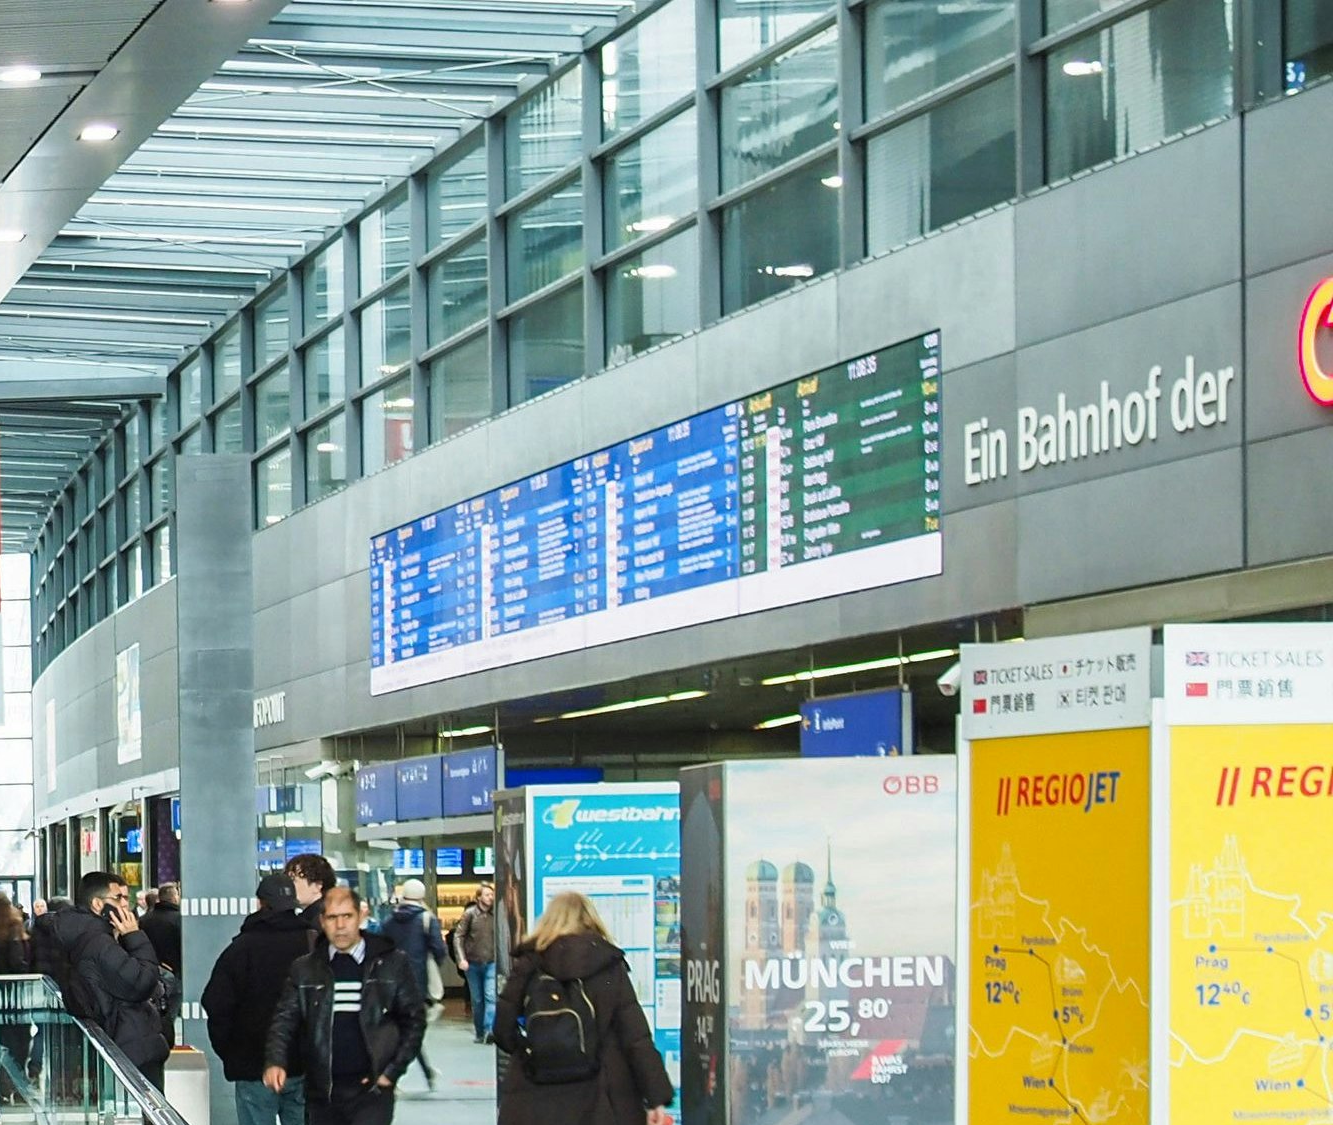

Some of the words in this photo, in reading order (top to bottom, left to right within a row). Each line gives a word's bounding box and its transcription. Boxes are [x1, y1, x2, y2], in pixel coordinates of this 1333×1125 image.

[963, 416, 1008, 486] Ein
[1017, 364, 1163, 472] Bahnhof
[1170, 354, 1234, 433] der
[1216, 650, 1269, 669] TICKET
[1275, 649, 1324, 668] SALES
[991, 667, 1022, 685] TICKET
[1023, 663, 1054, 682] SALES
[882, 775, 940, 795] ÖBB
[1016, 771, 1121, 813] REGIOJET
[744, 951, 946, 990] MÜNCHEN
[984, 955, 1007, 971] Prag
[1195, 955, 1230, 970] Prag
[687, 959, 721, 1005] PRAG
[1023, 1075, 1047, 1089] Wien
[1254, 1079, 1292, 1092] Wien
